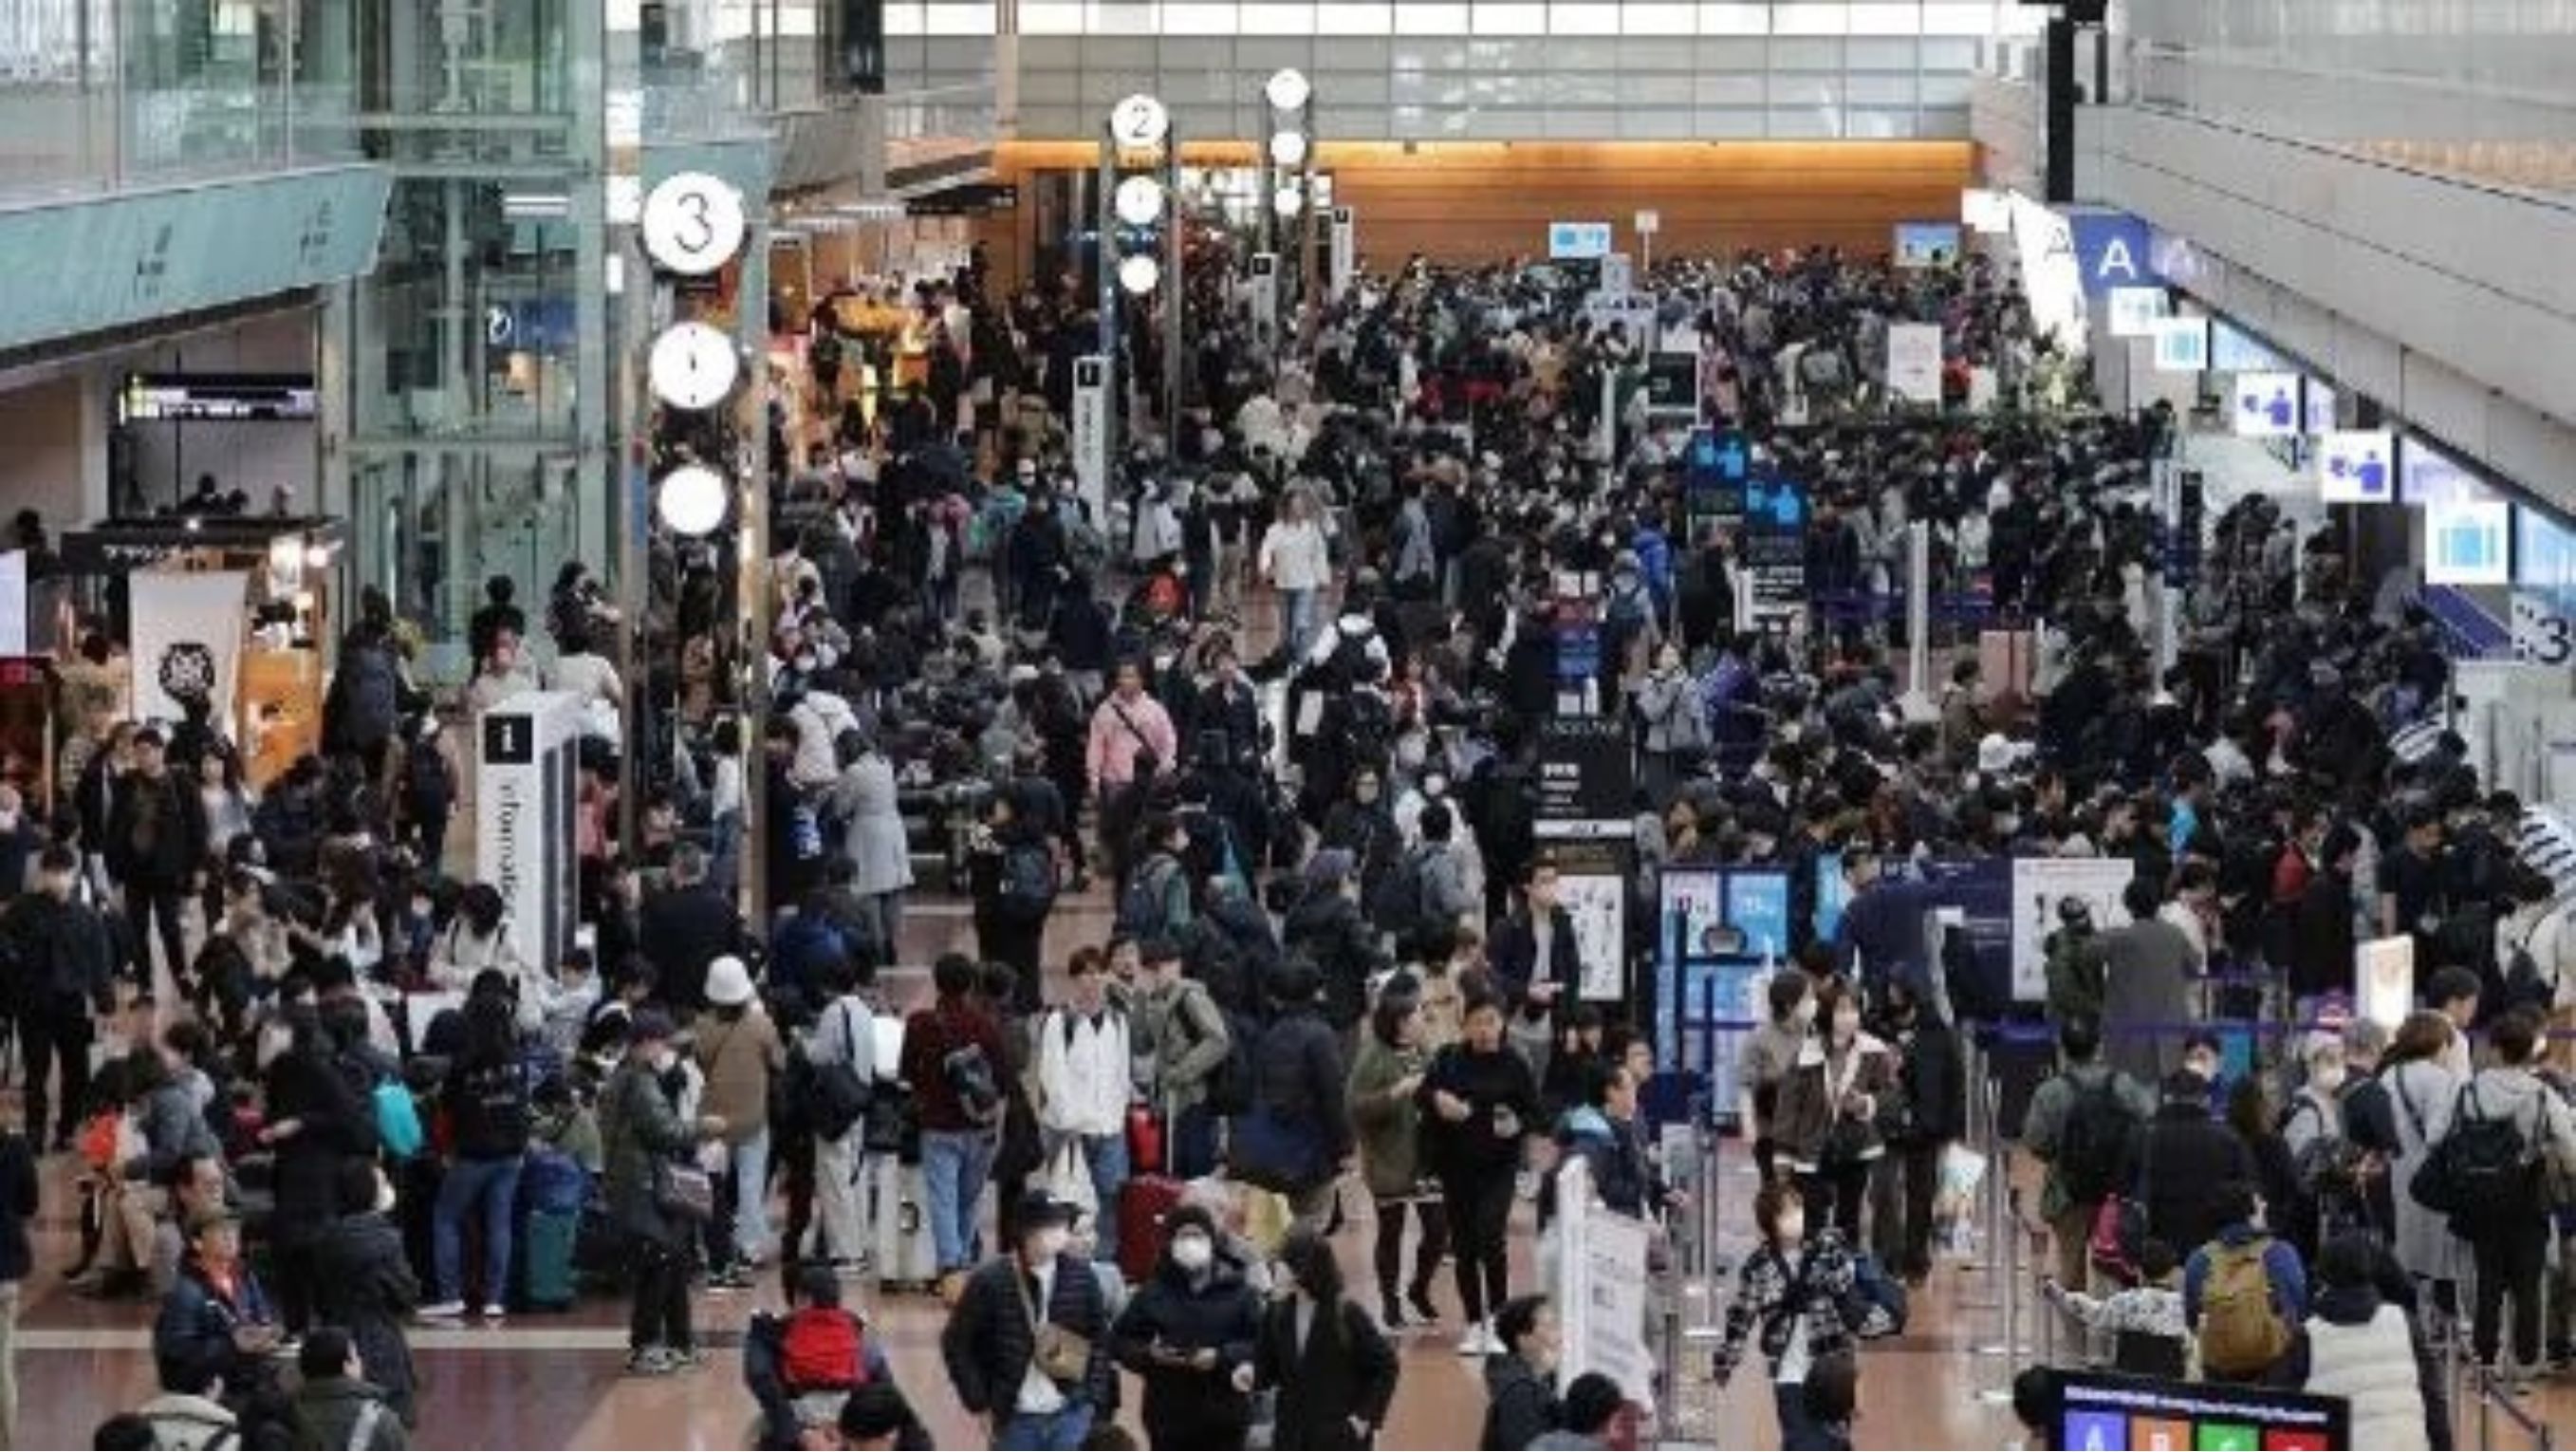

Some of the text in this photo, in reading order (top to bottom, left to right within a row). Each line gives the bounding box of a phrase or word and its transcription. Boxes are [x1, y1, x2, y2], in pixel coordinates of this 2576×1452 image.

[1131, 104, 1149, 138] 2
[674, 192, 713, 253] 3
[2097, 235, 2138, 280] A
